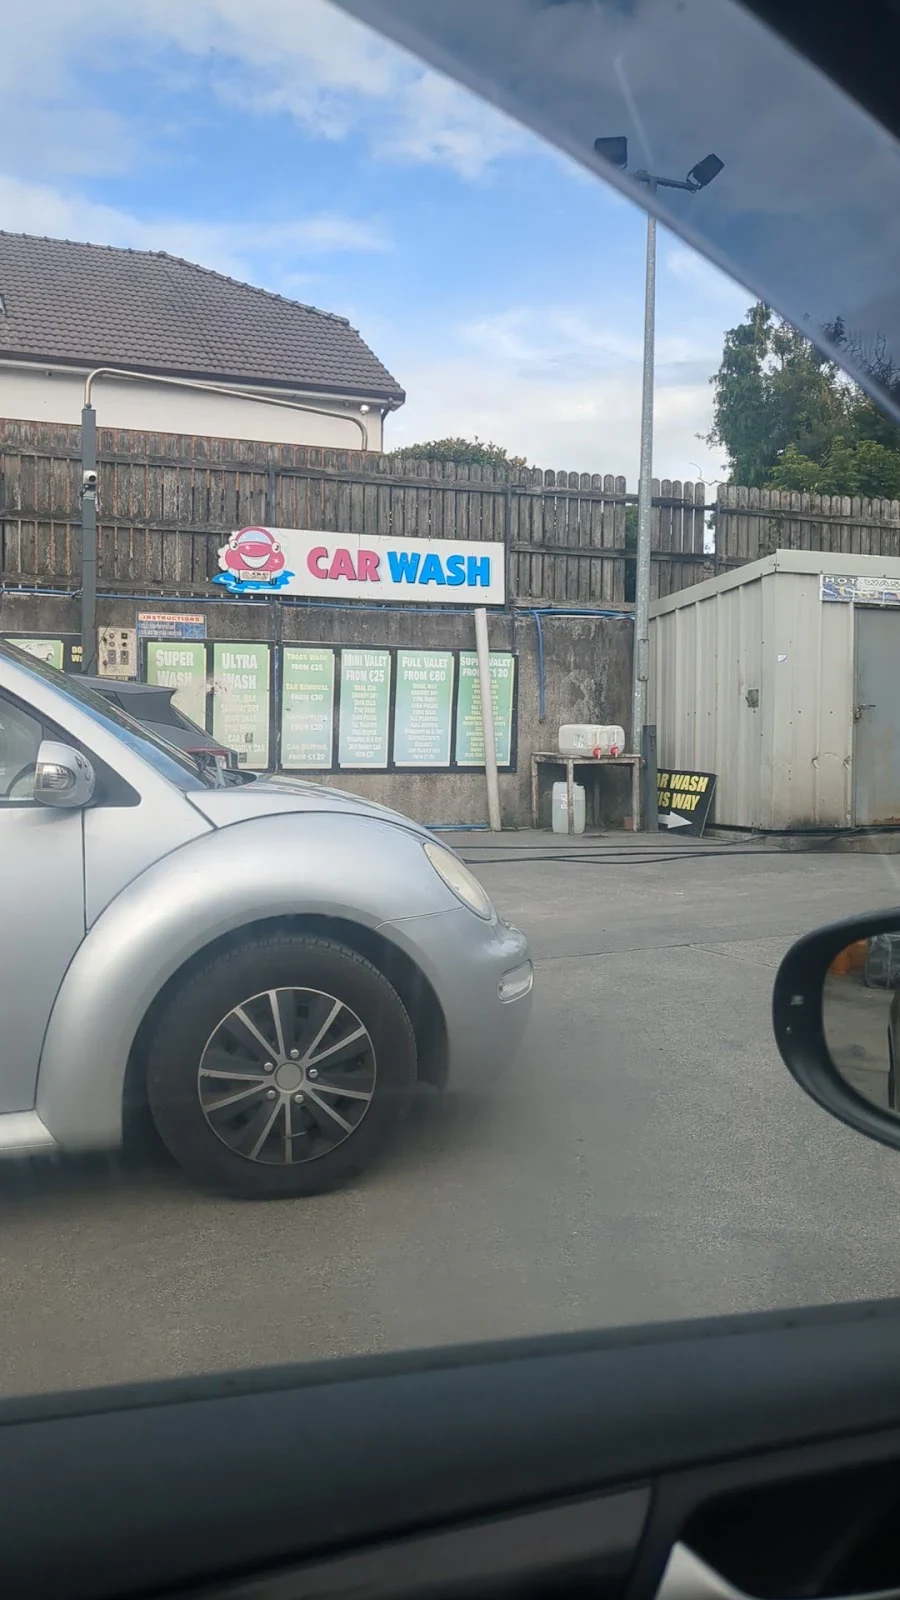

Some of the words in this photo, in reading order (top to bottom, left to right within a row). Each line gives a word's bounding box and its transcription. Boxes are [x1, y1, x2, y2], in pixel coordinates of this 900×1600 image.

[307, 547, 380, 582] CAR
[387, 551, 490, 587] WASH
[825, 576, 857, 585] HOT
[864, 579, 900, 588] WAS
[71, 645, 83, 655] DO
[156, 649, 194, 667] SUPER
[222, 652, 258, 669] ULTRA
[343, 653, 362, 666] MINI
[364, 654, 387, 667] VALET
[402, 656, 422, 667] FULL
[423, 657, 448, 668] VALET
[460, 656, 479, 666] SUP
[157, 671, 192, 687] WASH
[346, 669, 368, 681] FROM
[369, 669, 384, 682] €25
[404, 670, 427, 681] FROM
[428, 670, 446, 682] €80
[462, 668, 479, 677] FRO
[222, 673, 257, 690] WASH
[656, 773, 669, 788] AR
[670, 774, 709, 793] WASH
[657, 791, 671, 807] IS
[671, 793, 701, 811] WAY
